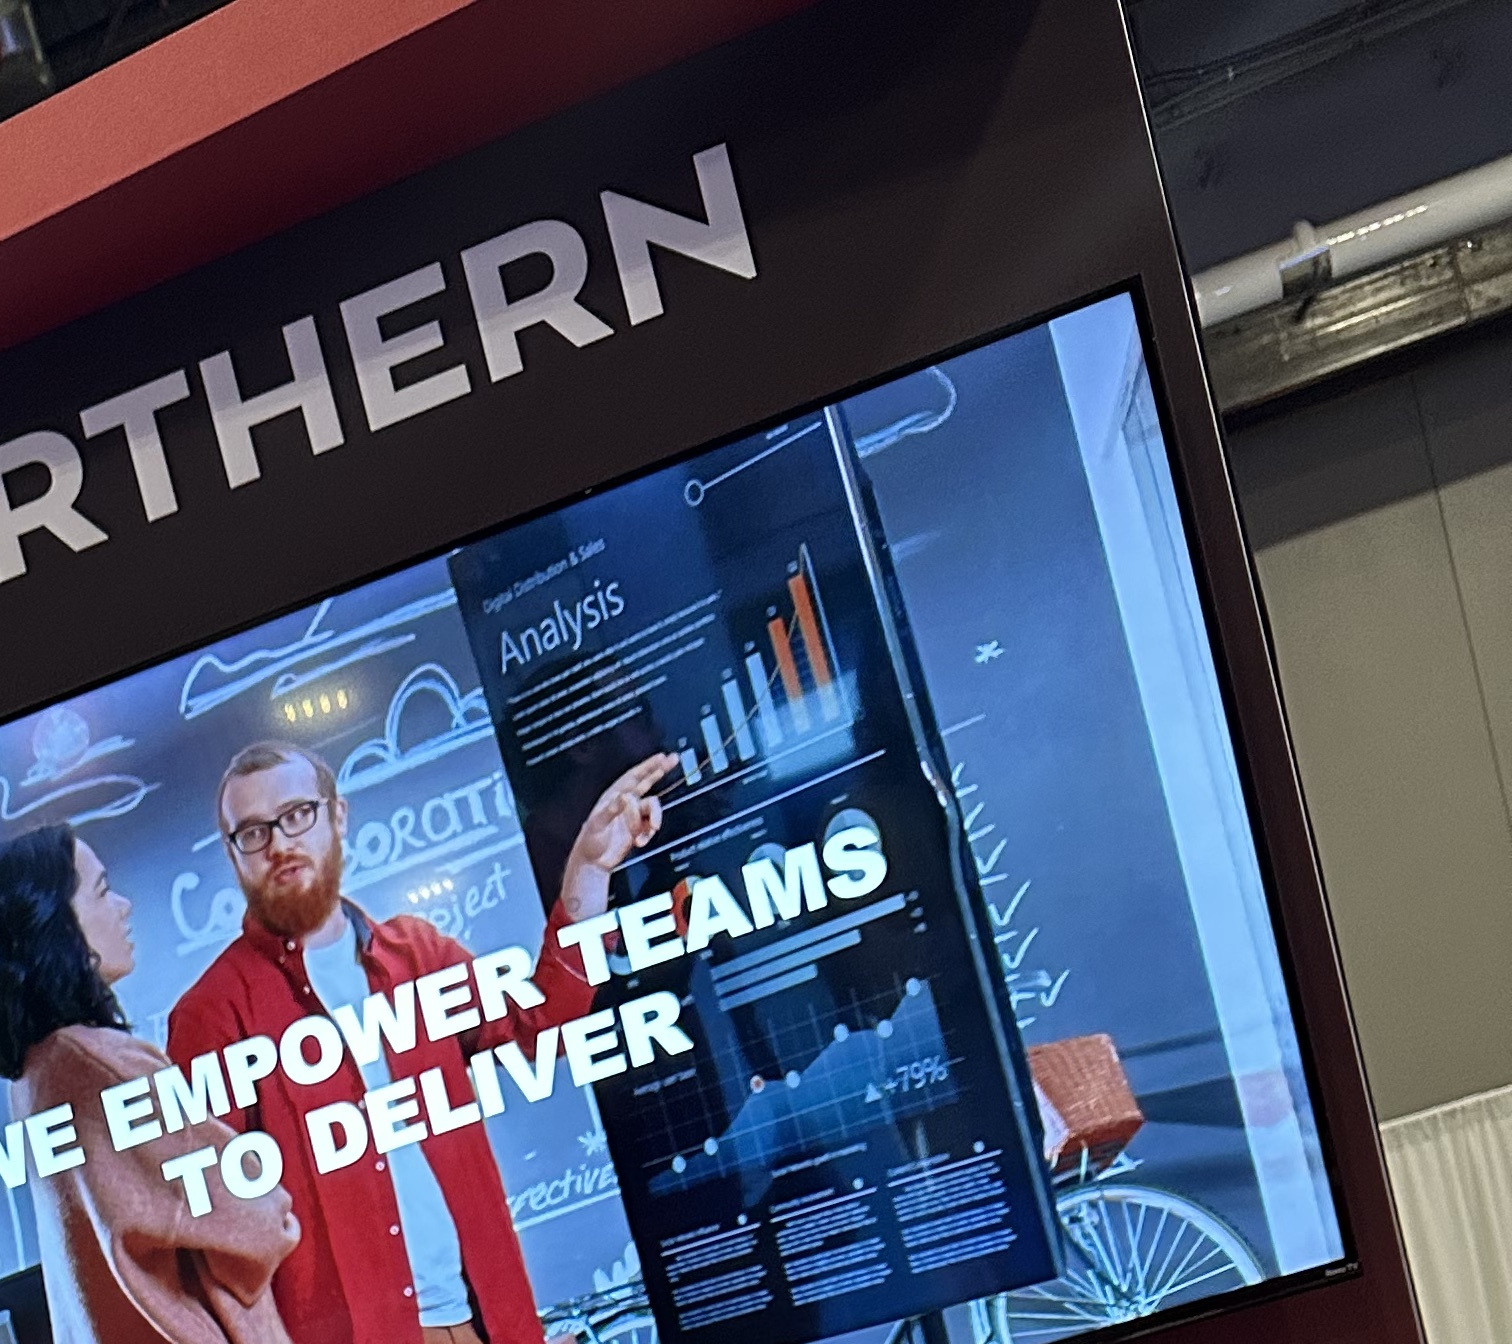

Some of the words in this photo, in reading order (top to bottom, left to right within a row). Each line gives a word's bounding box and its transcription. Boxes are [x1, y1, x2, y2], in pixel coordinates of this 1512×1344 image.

[500, 578, 625, 675] Analysis
[101, 946, 546, 1153] EMPOWER
[557, 825, 888, 988] TEAMS
[163, 1131, 284, 1218] TO
[305, 990, 695, 1175] DELIVER
